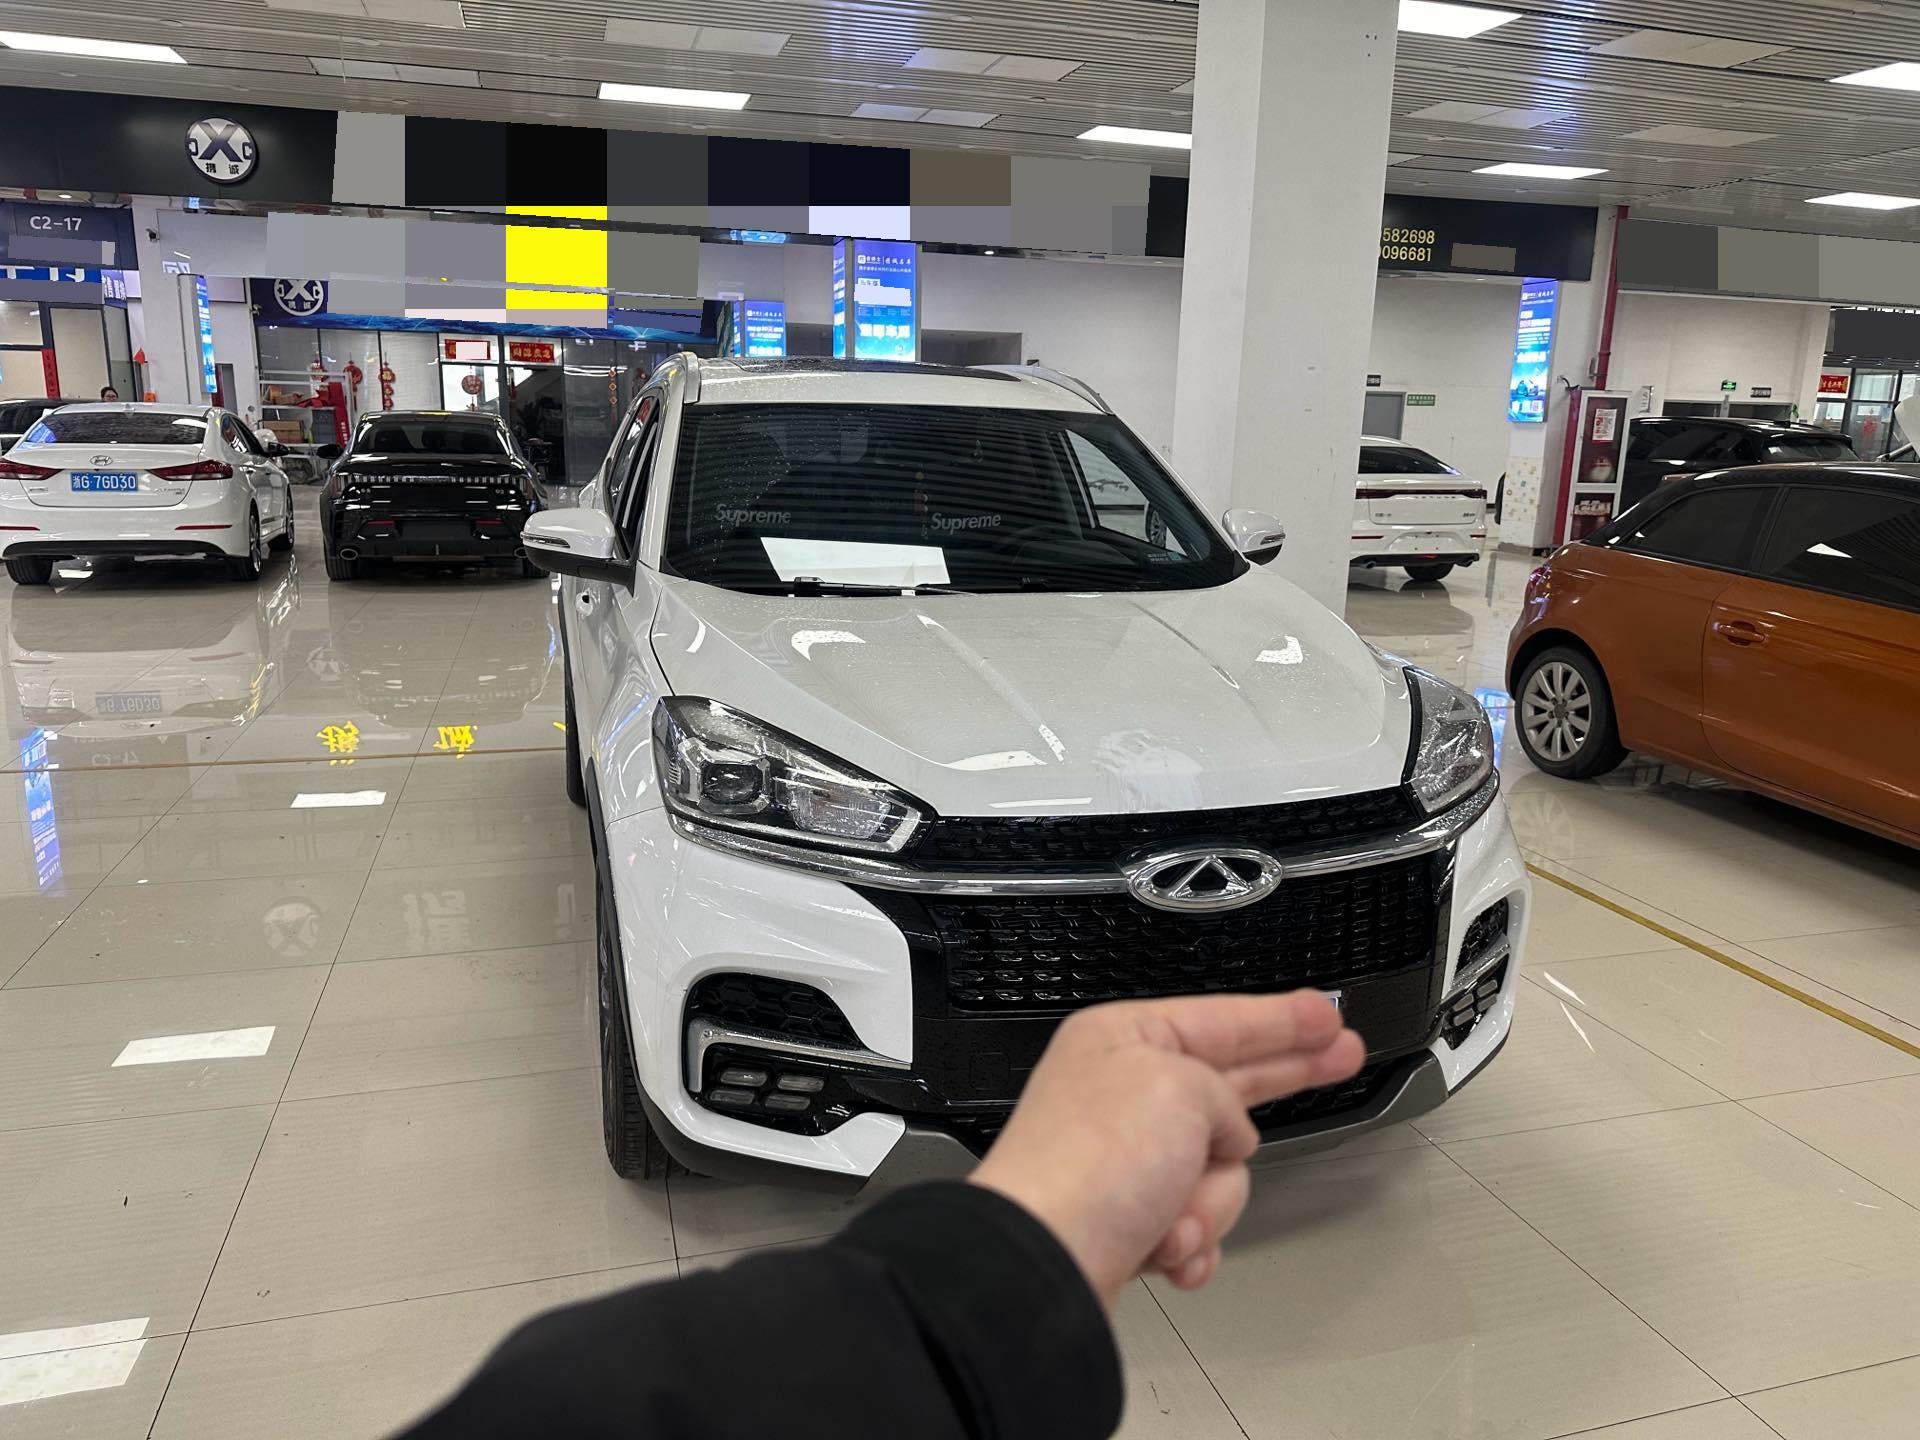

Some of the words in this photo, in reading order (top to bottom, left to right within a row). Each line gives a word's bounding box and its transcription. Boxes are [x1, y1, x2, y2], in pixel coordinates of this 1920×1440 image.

[29, 216, 83, 231] C2-17
[1380, 227, 1436, 245] 582698
[1379, 245, 1432, 262] 096681
[713, 503, 792, 526] Supreme
[930, 512, 1002, 536] Supreme
